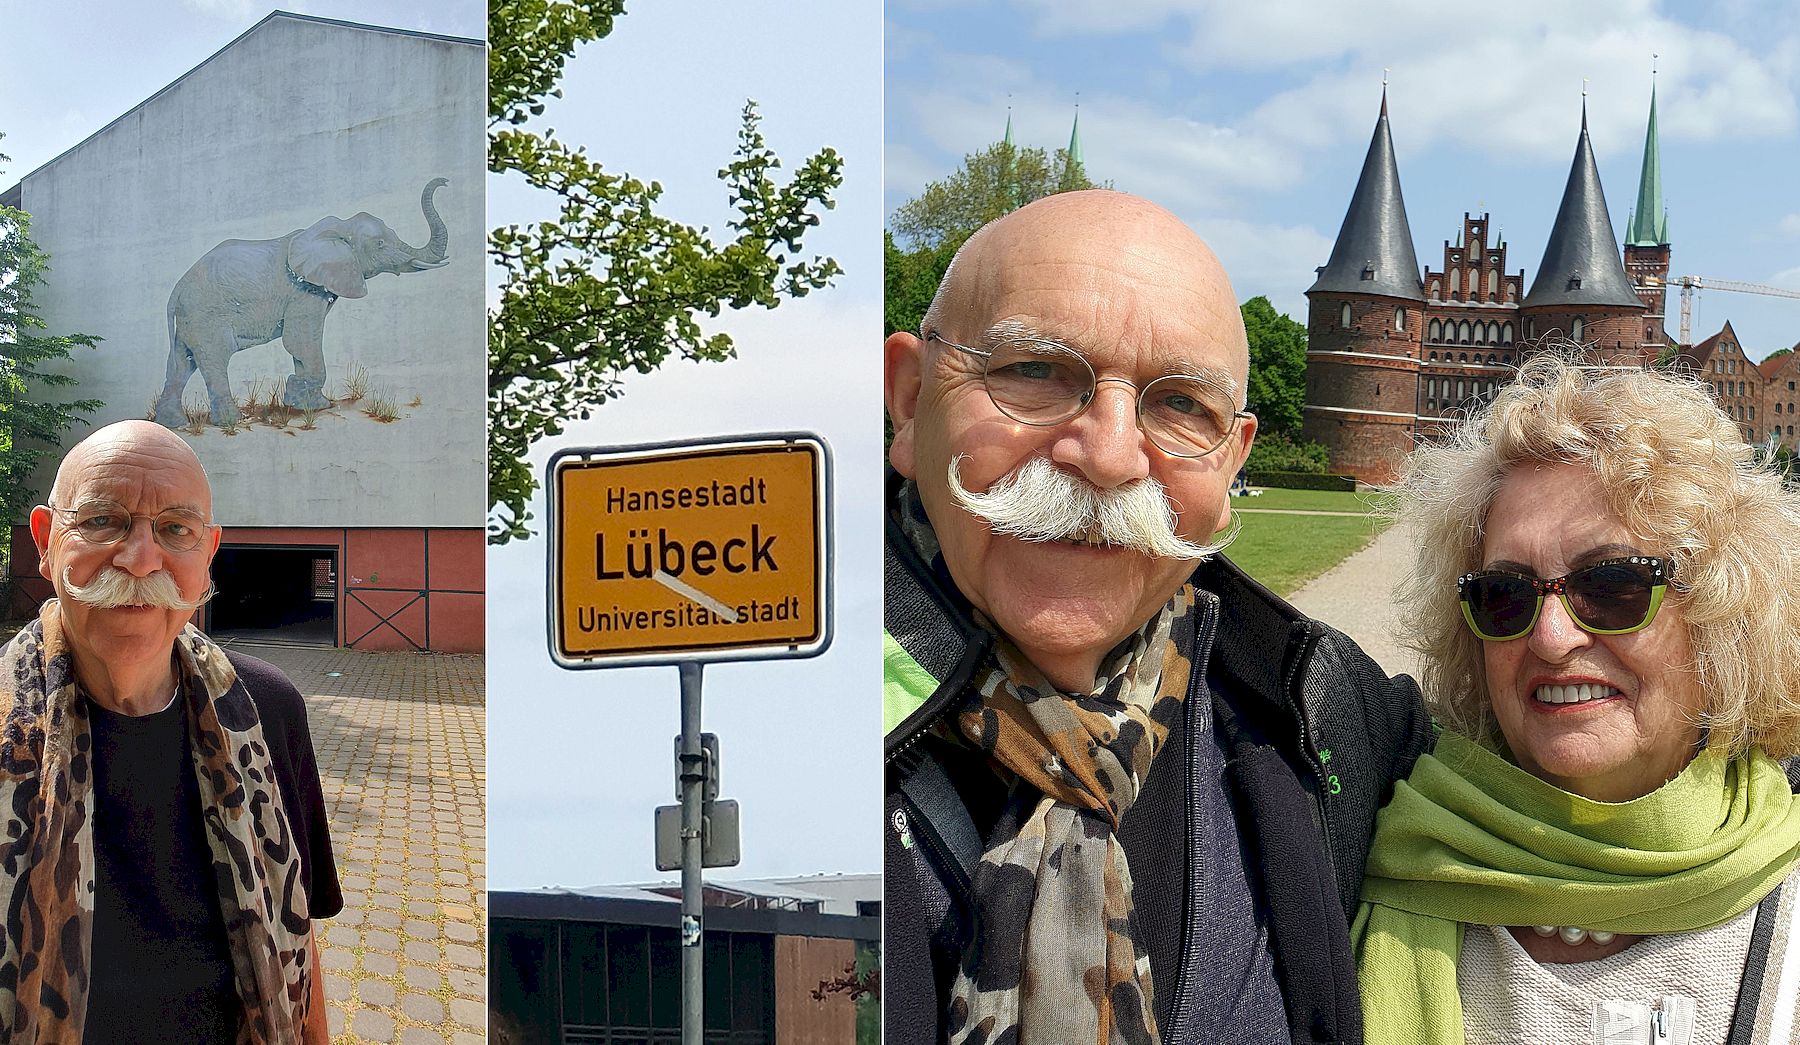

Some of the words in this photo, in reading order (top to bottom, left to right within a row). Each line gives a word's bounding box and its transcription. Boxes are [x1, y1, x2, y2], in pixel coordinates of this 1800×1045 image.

[606, 477, 767, 514] Hansestadt
[595, 523, 780, 581] Lübeck
[577, 596, 800, 633] Universitätstadt
